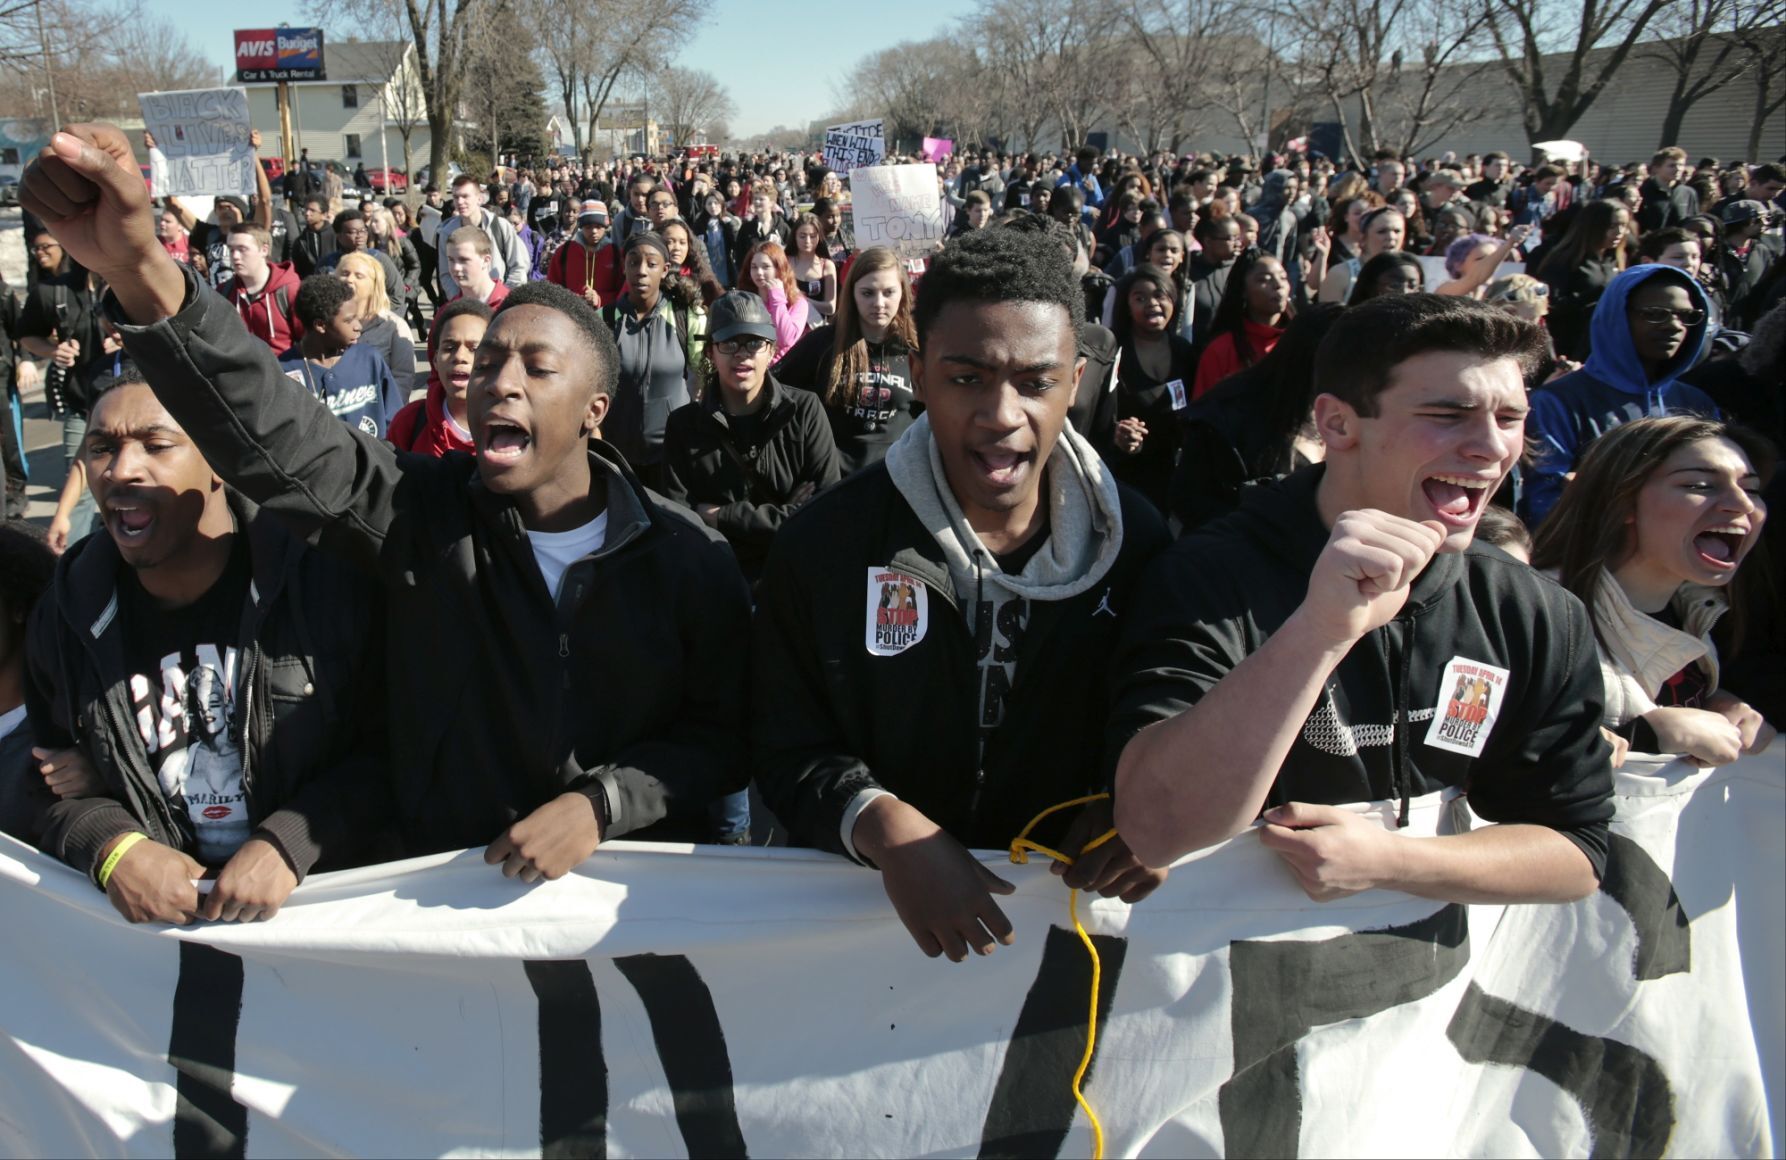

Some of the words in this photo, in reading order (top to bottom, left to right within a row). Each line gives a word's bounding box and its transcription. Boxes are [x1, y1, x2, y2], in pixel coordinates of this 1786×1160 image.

[237, 40, 275, 57] AVIS
[277, 35, 318, 51] Budget
[243, 71, 258, 79] Car
[260, 71, 267, 79] &
[269, 70, 288, 79] Truck
[290, 69, 315, 78] Rental
[146, 88, 242, 121] BLACK
[159, 121, 250, 157] LIVES
[826, 132, 849, 147] WHEN
[825, 145, 854, 161] THIS
[861, 208, 942, 241] TONY
[845, 404, 898, 420] TRACK
[877, 607, 918, 625] STOP
[876, 624, 907, 633] MURDER
[908, 625, 917, 634] BY
[875, 631, 917, 646] POLICE
[1452, 664, 1478, 675] TUESDAY
[1448, 699, 1488, 724] STOP
[1444, 715, 1471, 729] MURDER
[1438, 722, 1479, 743] POLICE
[186, 791, 245, 806] MARILY
